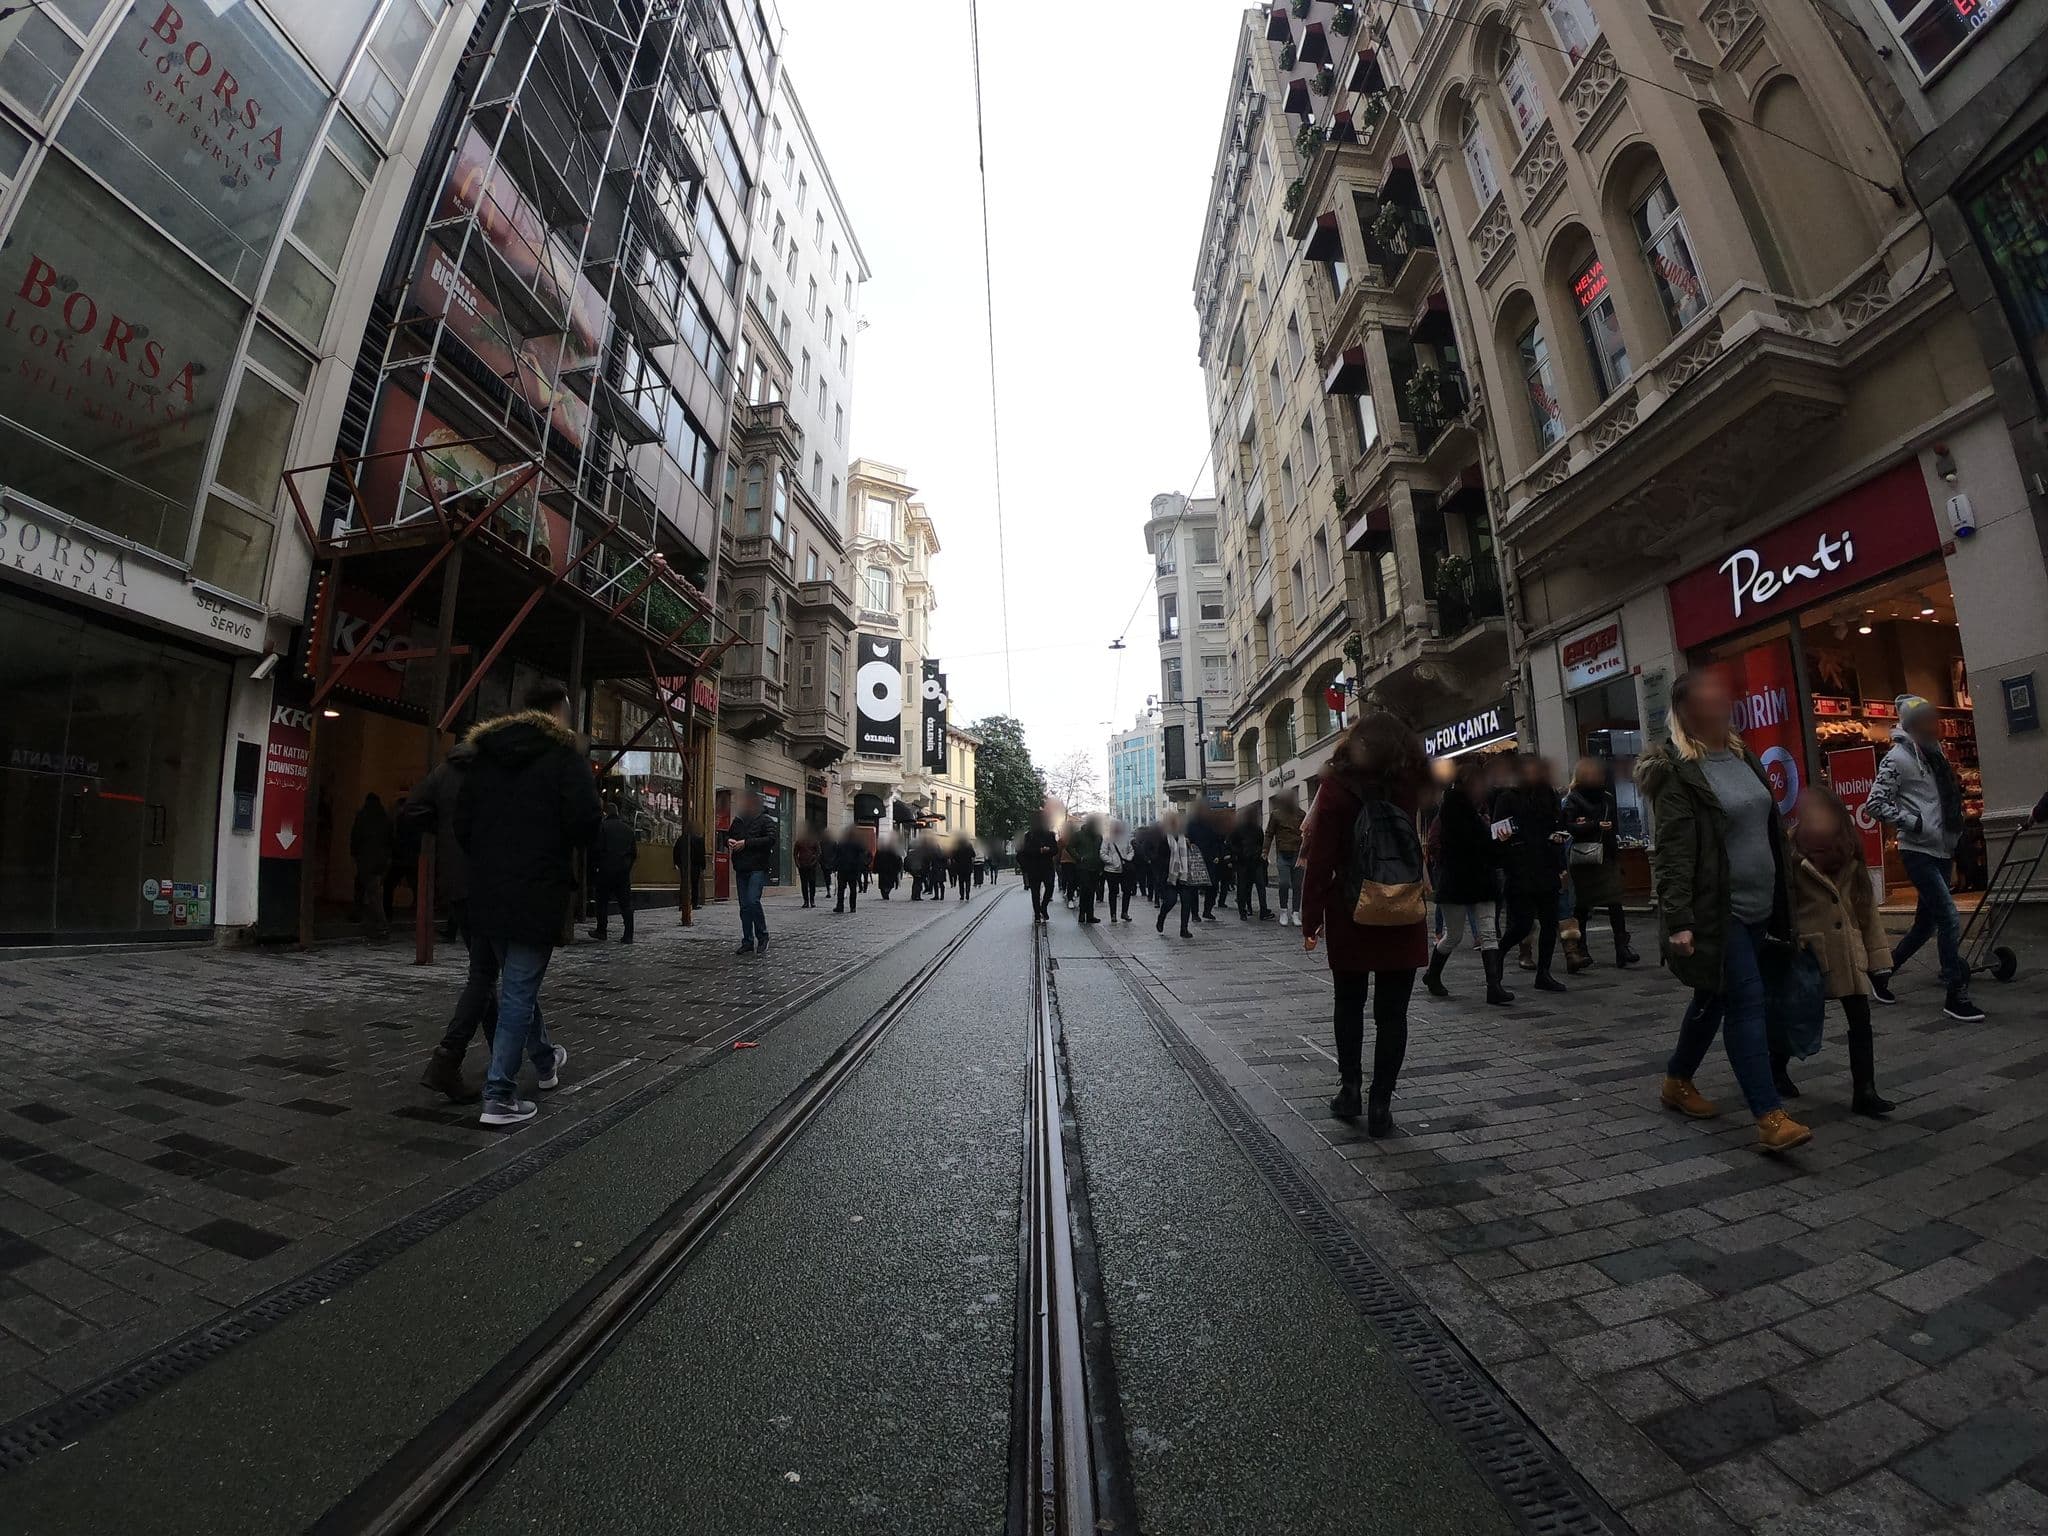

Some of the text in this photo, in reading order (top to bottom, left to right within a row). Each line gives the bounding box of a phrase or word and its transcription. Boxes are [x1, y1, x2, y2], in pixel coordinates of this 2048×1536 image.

[144, 80, 190, 126] SELF
[151, 2, 283, 161] BORSA
[138, 37, 276, 182] LOKANTASI
[16, 252, 194, 404] BORSA
[1719, 530, 1854, 618] Penti
[196, 595, 227, 616] SELF
[210, 615, 252, 640] SERVİS
[1588, 657, 1620, 676] OPTİK
[269, 743, 283, 756] ALT
[1424, 709, 1500, 756] by FOX ÇANTA
